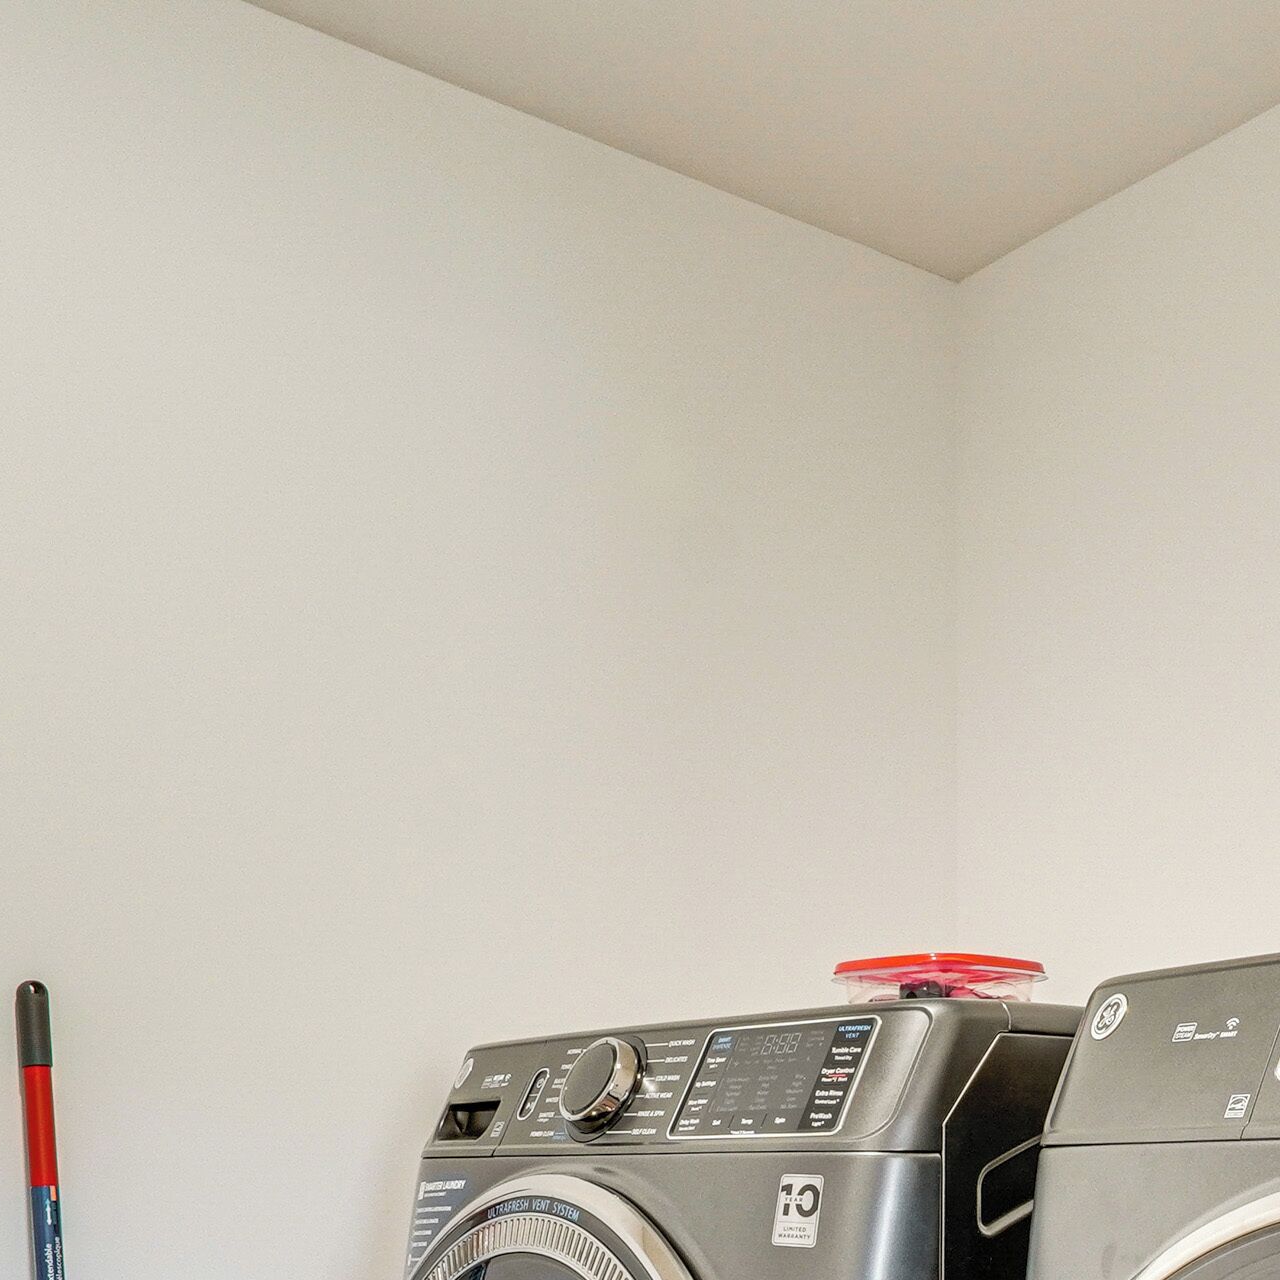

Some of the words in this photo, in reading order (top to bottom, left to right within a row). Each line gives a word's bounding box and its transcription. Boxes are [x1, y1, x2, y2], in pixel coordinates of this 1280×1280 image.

[487, 1199, 528, 1219] ULTRAFRESH
[532, 1199, 550, 1210] VENT
[552, 1202, 580, 1221] SYSTEM
[781, 1183, 820, 1218] 10
